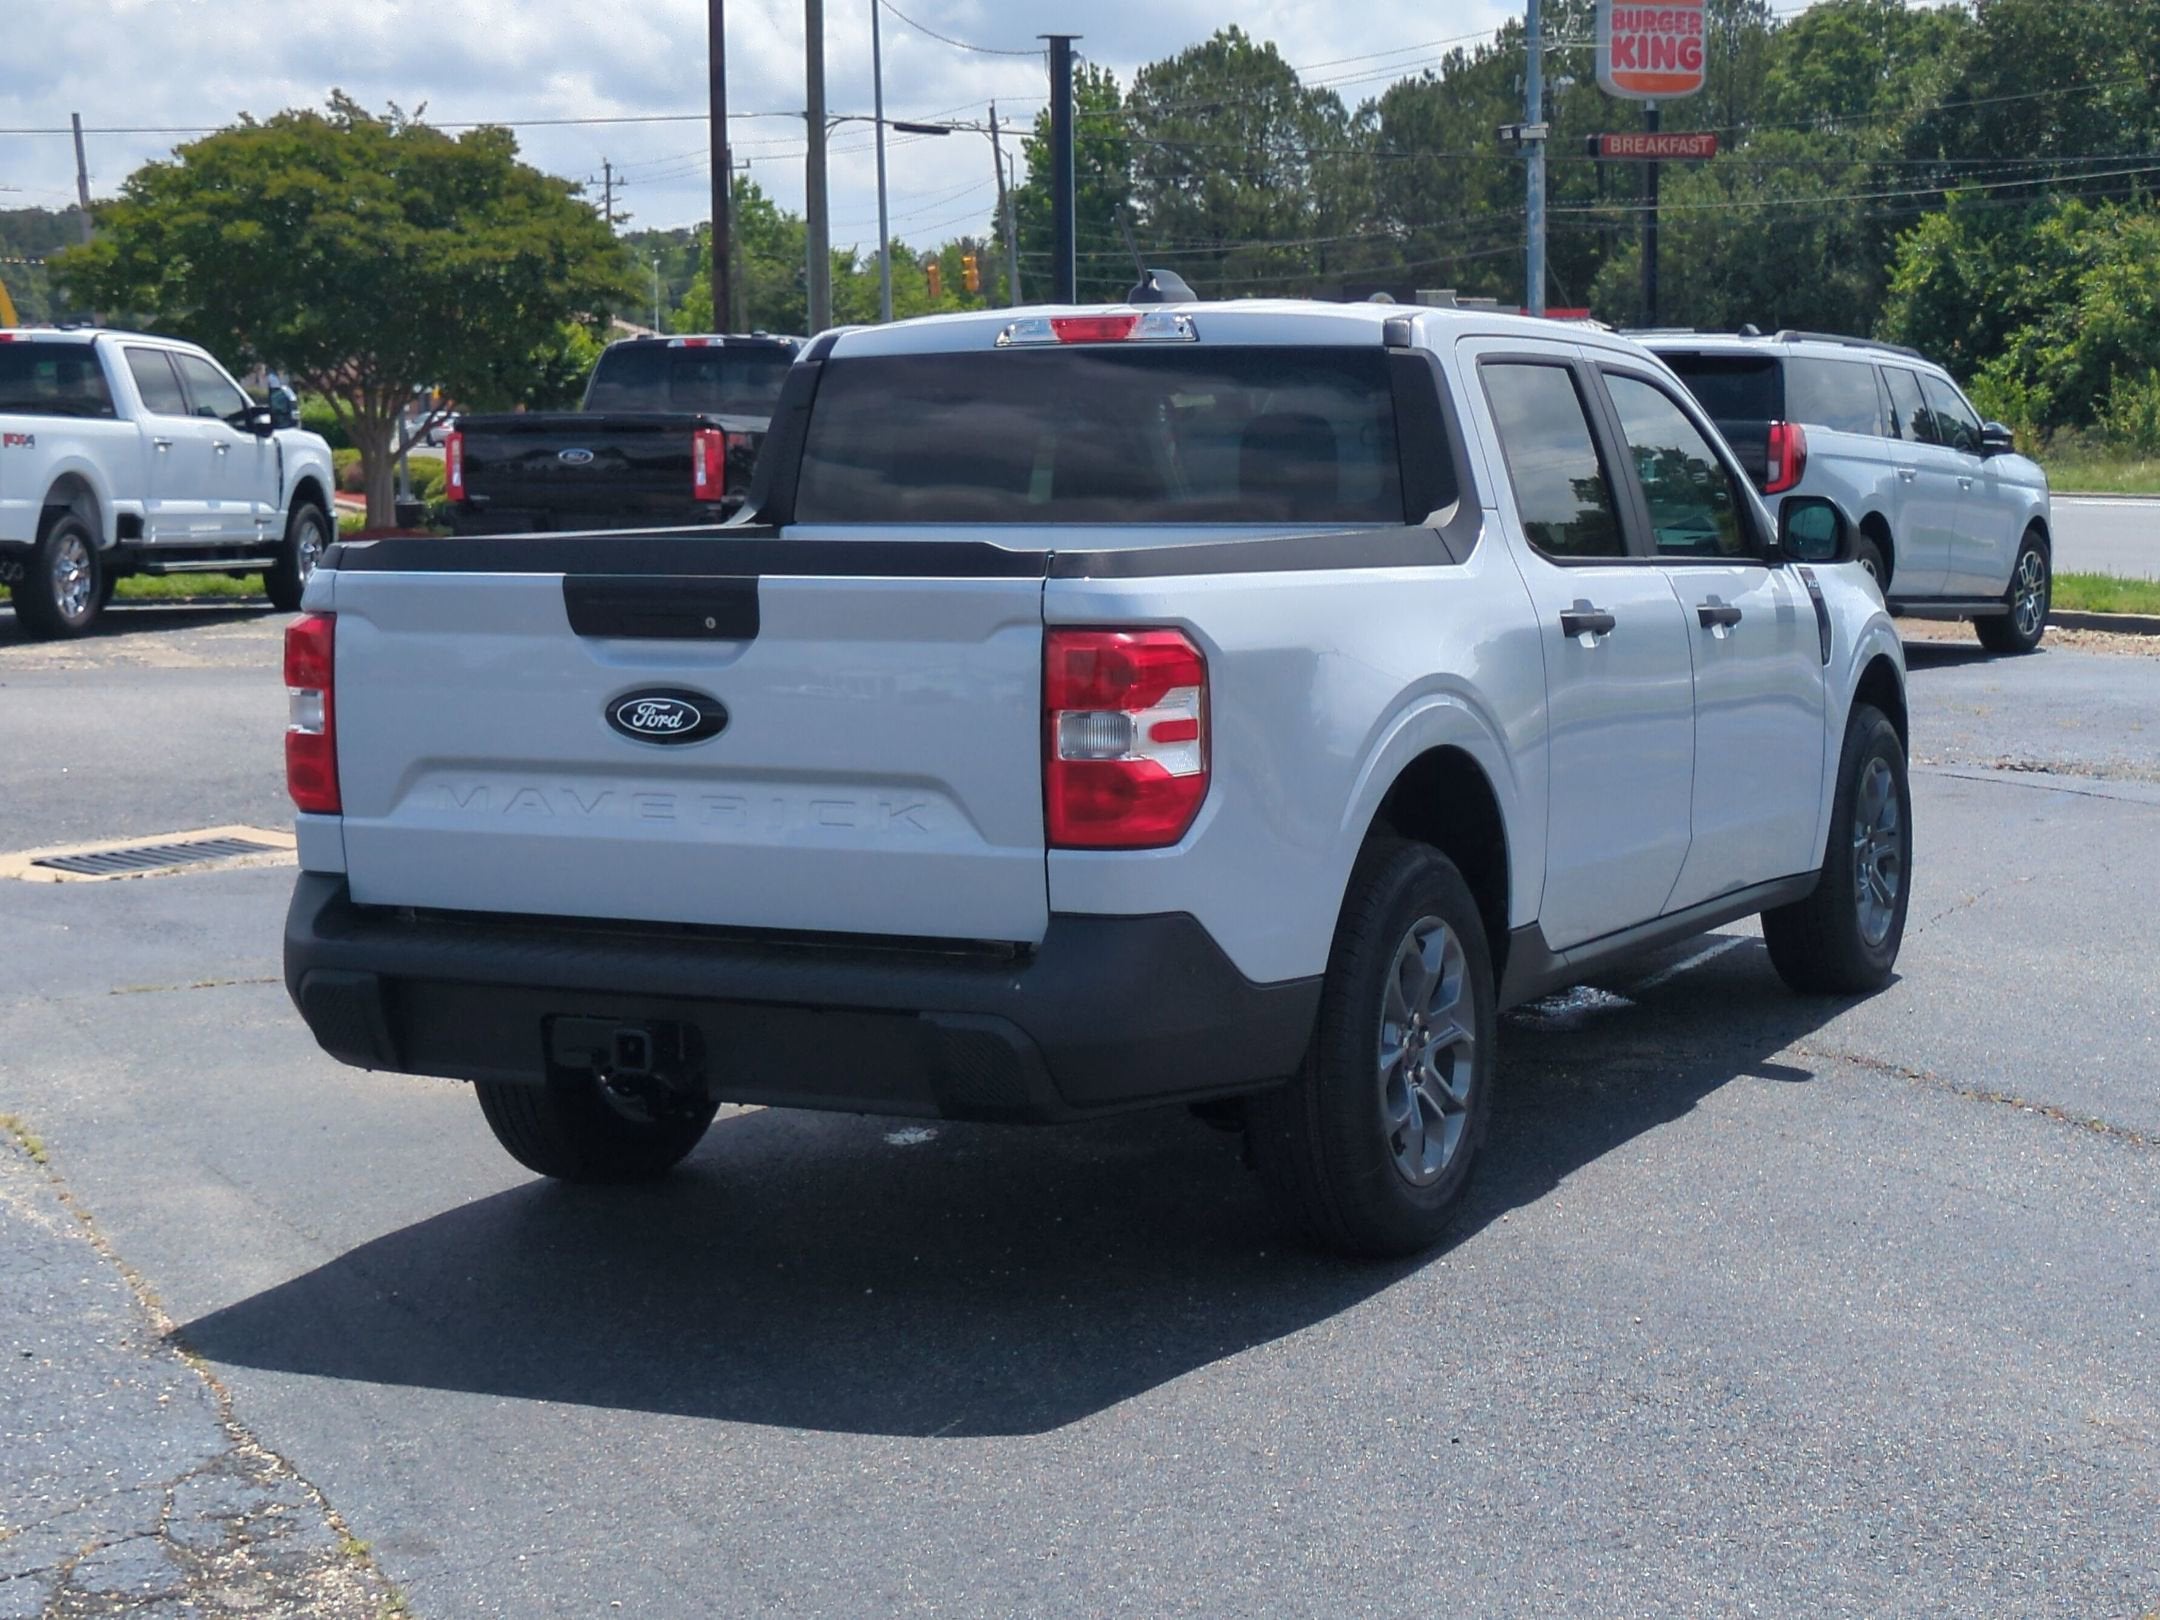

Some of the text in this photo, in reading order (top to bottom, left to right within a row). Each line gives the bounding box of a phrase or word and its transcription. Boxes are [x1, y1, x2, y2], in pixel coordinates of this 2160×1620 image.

[1611, 9, 1703, 35] BURGER
[1611, 34, 1703, 70] KING
[1610, 137, 1709, 153] BREAKFAST
[633, 702, 684, 728] Ford
[434, 785, 929, 834] MAVERICK
